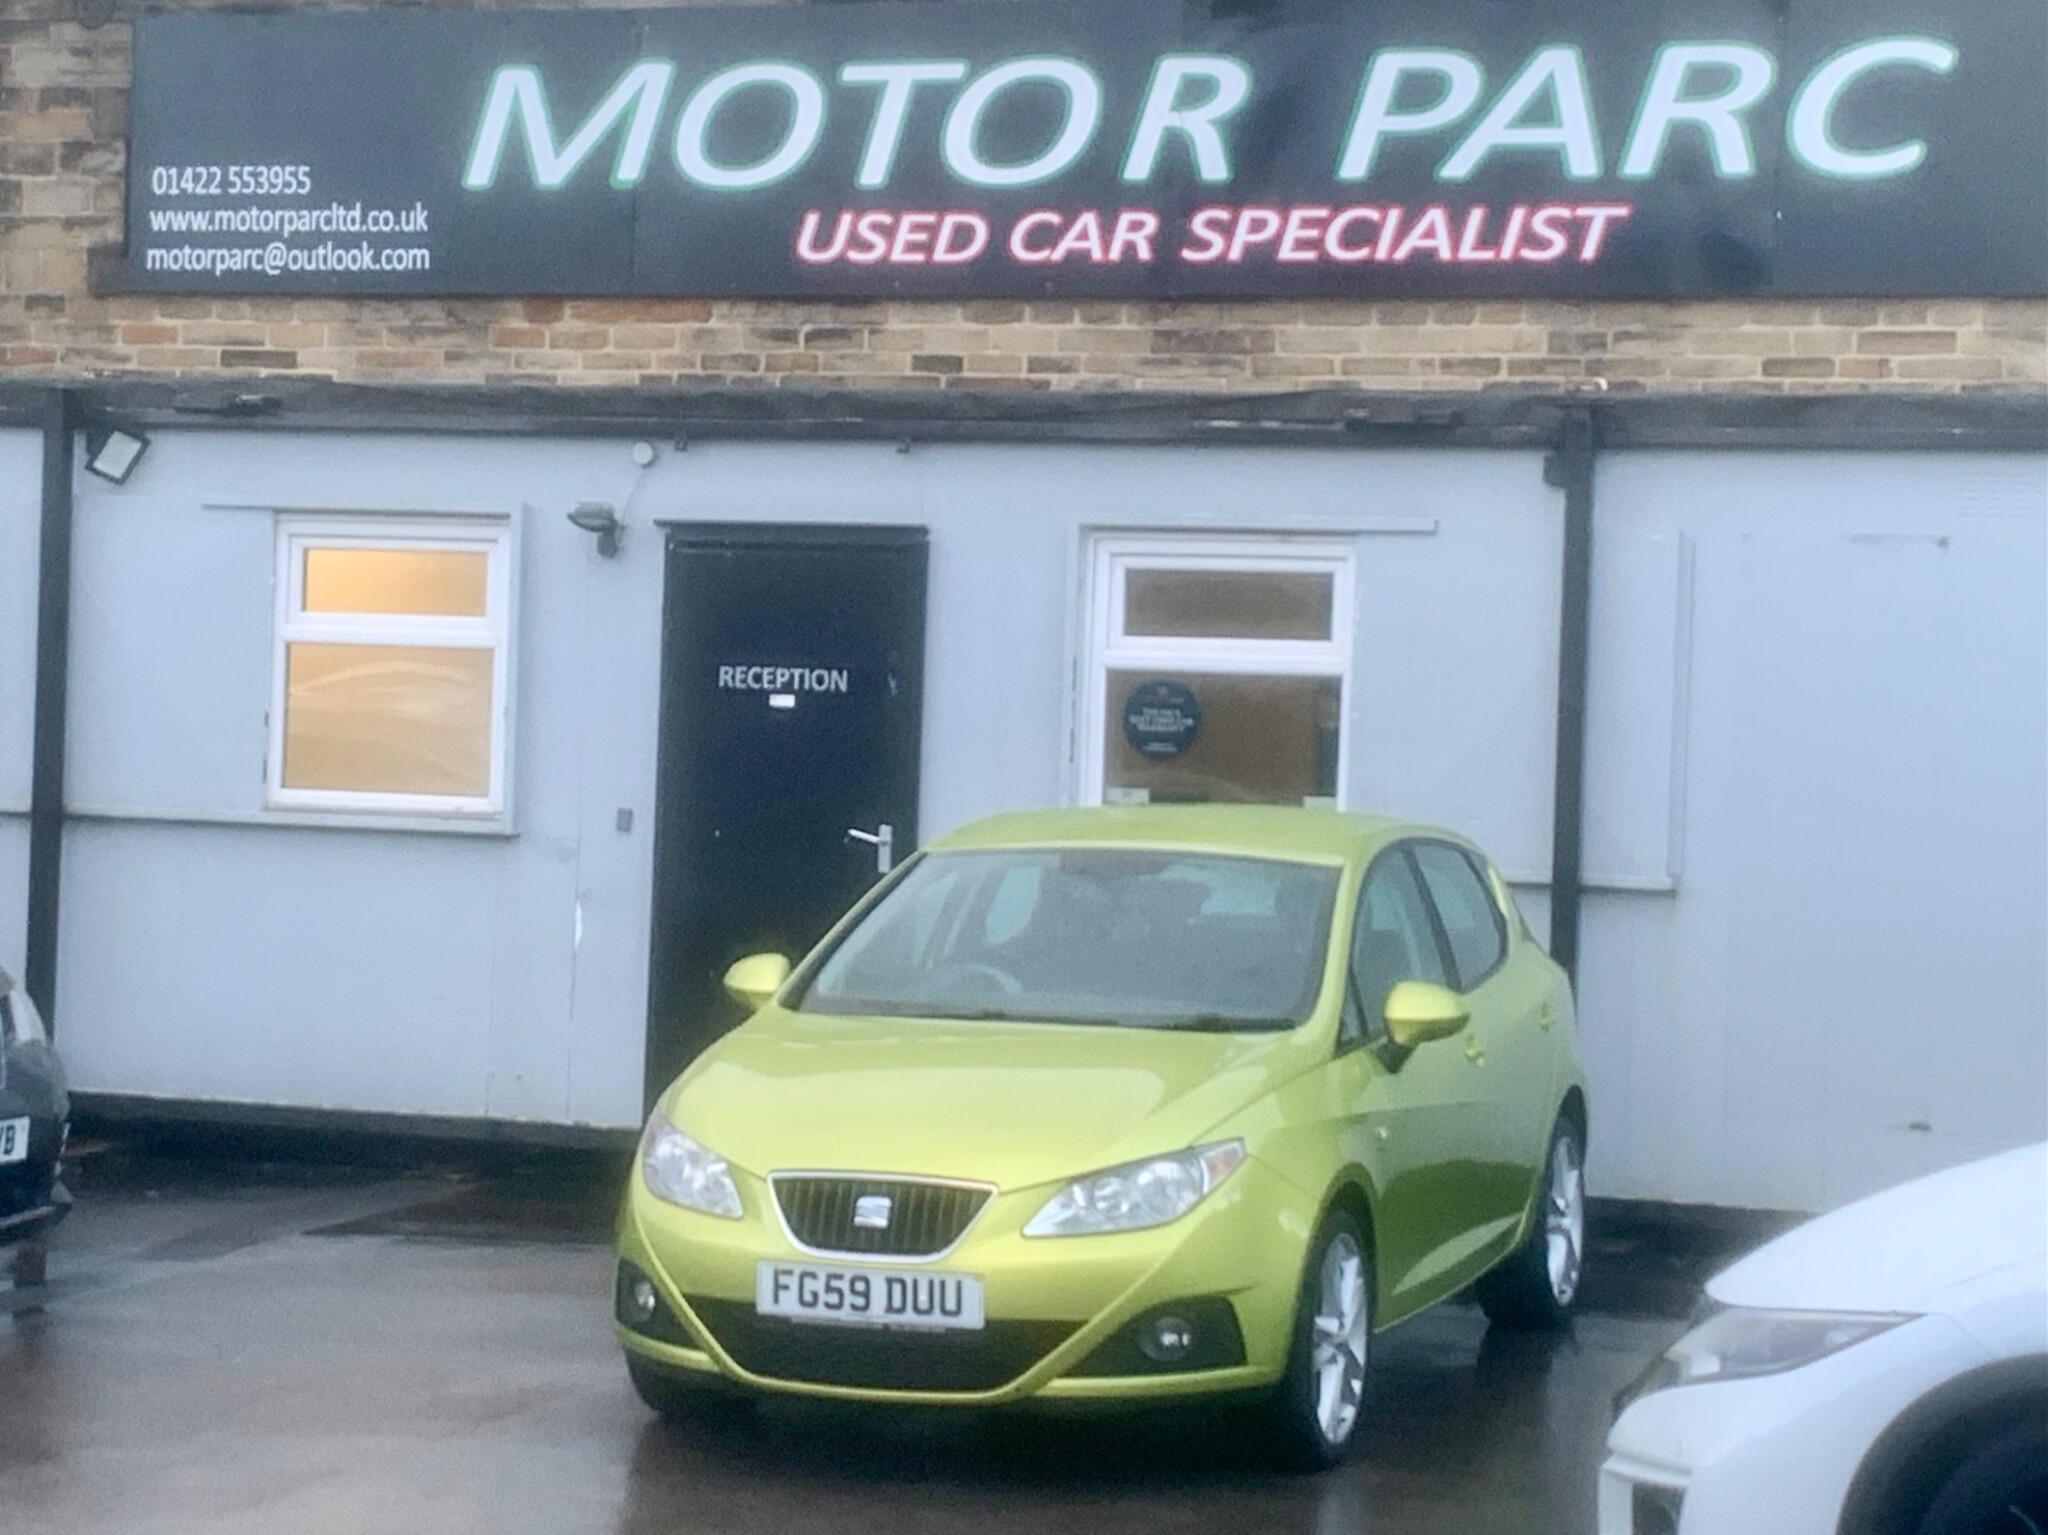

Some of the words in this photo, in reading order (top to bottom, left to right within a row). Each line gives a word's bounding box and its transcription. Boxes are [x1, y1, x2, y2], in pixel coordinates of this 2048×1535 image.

[463, 54, 1250, 188] MOTOR
[1335, 37, 1957, 180] PARC
[152, 166, 221, 195] 01422
[227, 165, 311, 194] 553955
[149, 202, 429, 238] www.motorparcltd.co.uk
[797, 210, 988, 264] USED
[1008, 209, 1160, 263] CAR
[1181, 202, 1632, 264] SPECIALIST
[146, 241, 431, 276] motorparc@outlook.com
[718, 665, 849, 693] RECEPTION
[772, 1267, 871, 1313] FG59
[884, 1276, 963, 1318] DUU
